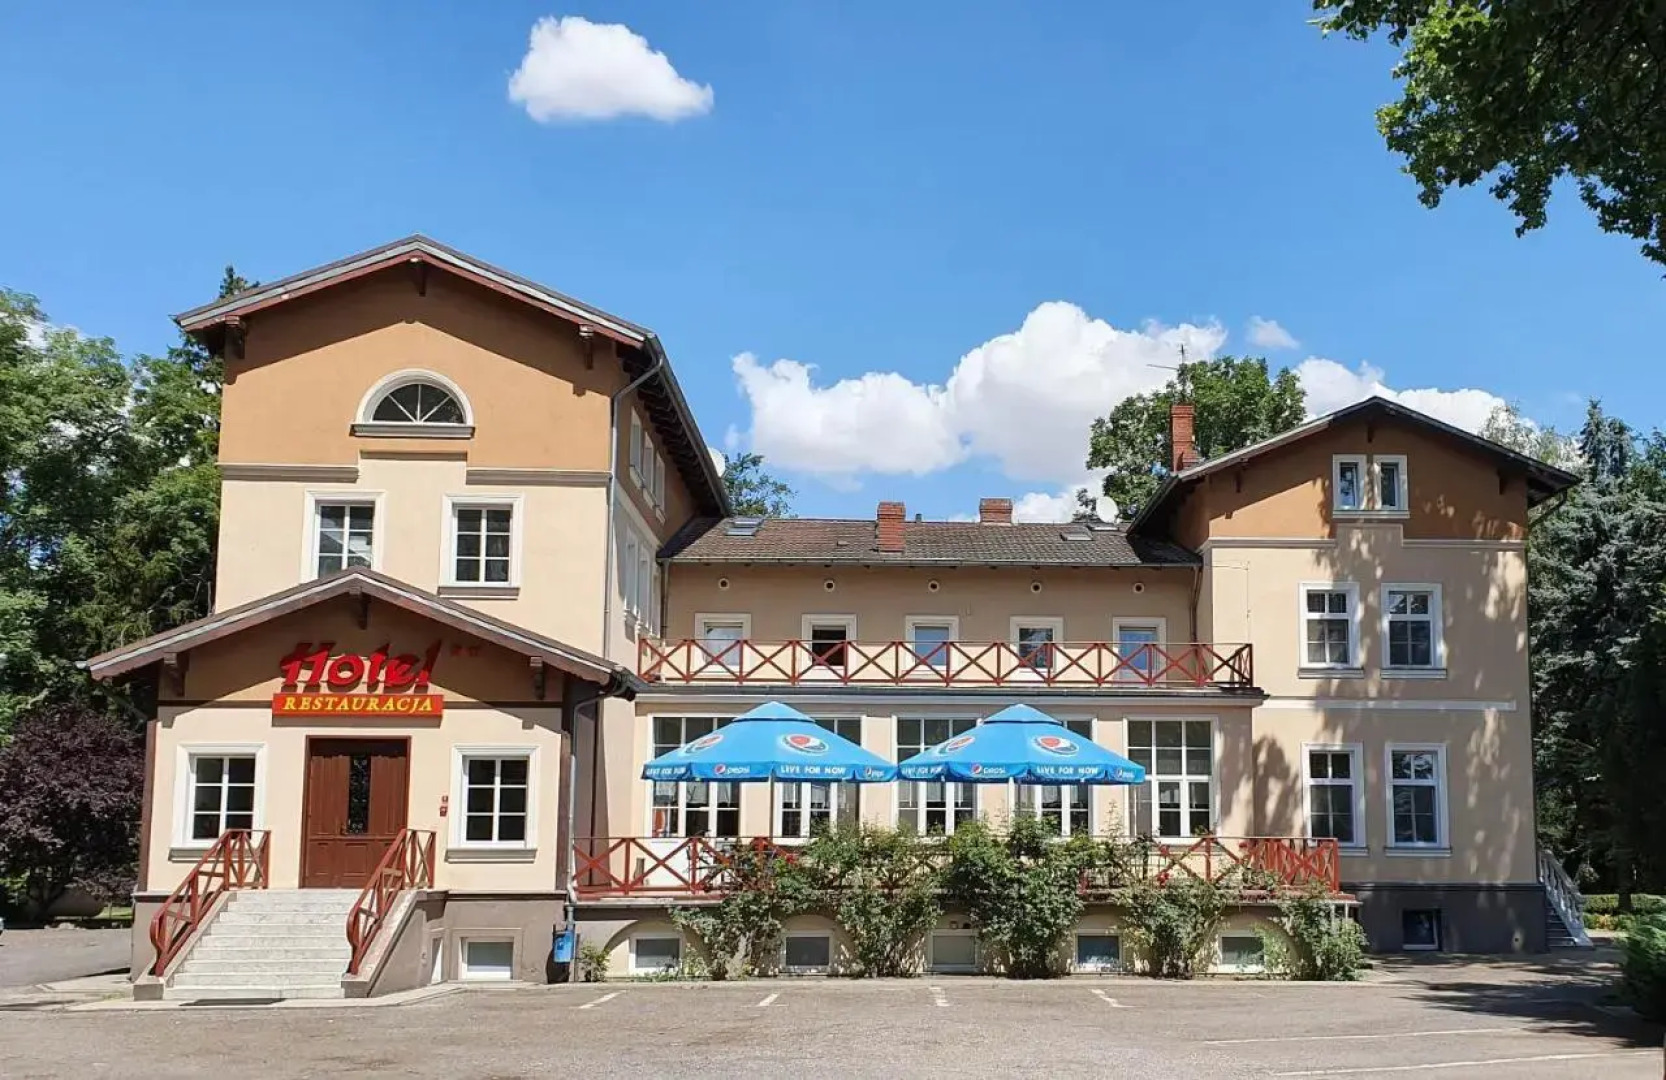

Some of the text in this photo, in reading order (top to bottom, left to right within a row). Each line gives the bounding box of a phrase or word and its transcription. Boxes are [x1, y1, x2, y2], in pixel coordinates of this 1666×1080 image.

[279, 640, 442, 687] Hotel
[282, 696, 433, 714] RESTAURACJA
[780, 765, 847, 776] LIVE FOR NOW
[1036, 766, 1099, 776] LIVE FOR NOW
